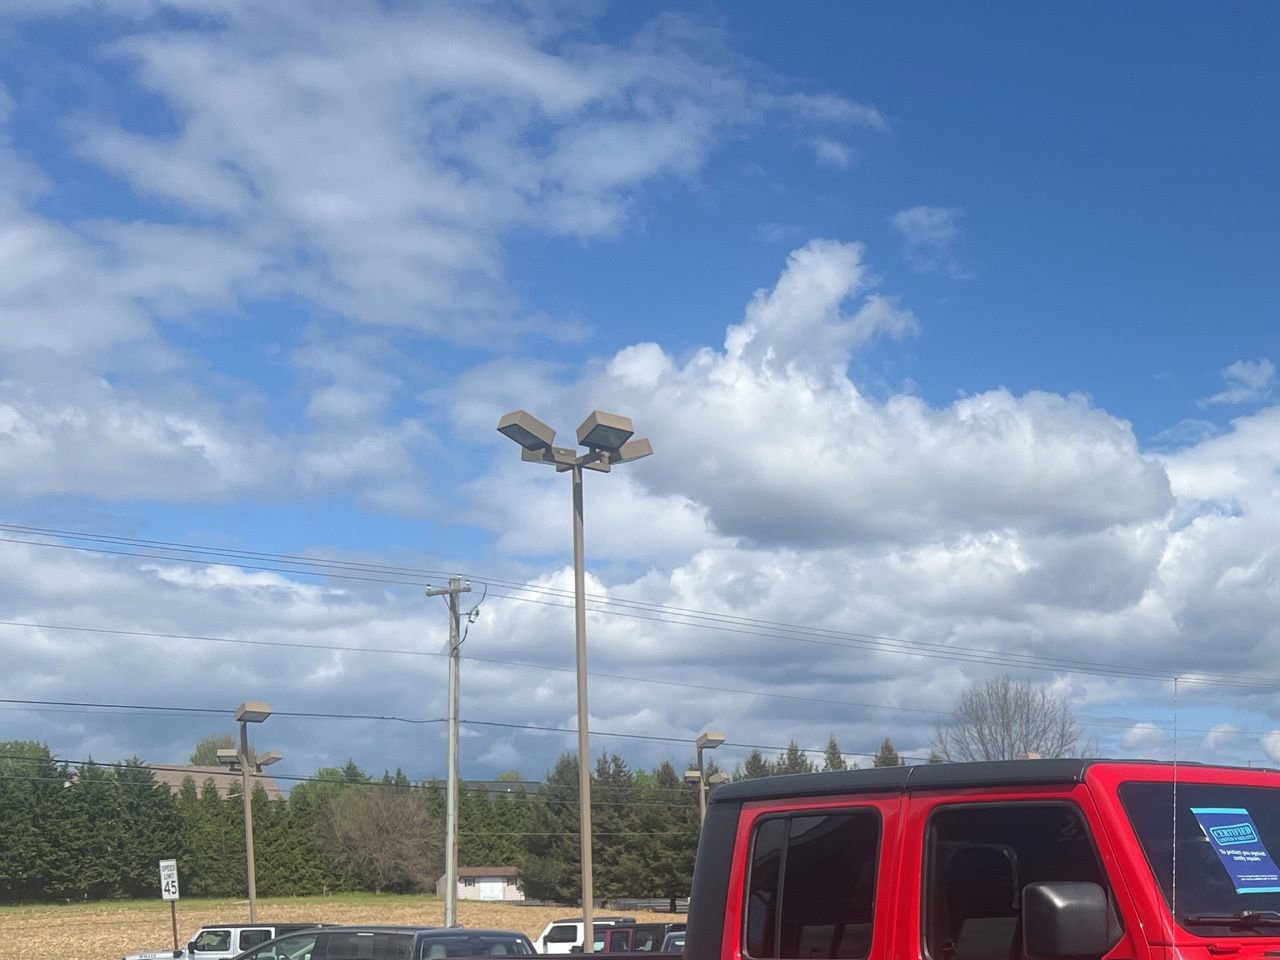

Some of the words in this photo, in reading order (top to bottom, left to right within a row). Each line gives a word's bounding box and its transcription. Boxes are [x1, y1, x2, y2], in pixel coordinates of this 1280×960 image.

[1213, 826, 1252, 838] CERTIFIED
[162, 864, 176, 872] SPEED
[164, 872, 175, 880] LIMIT
[164, 880, 177, 895] 45
